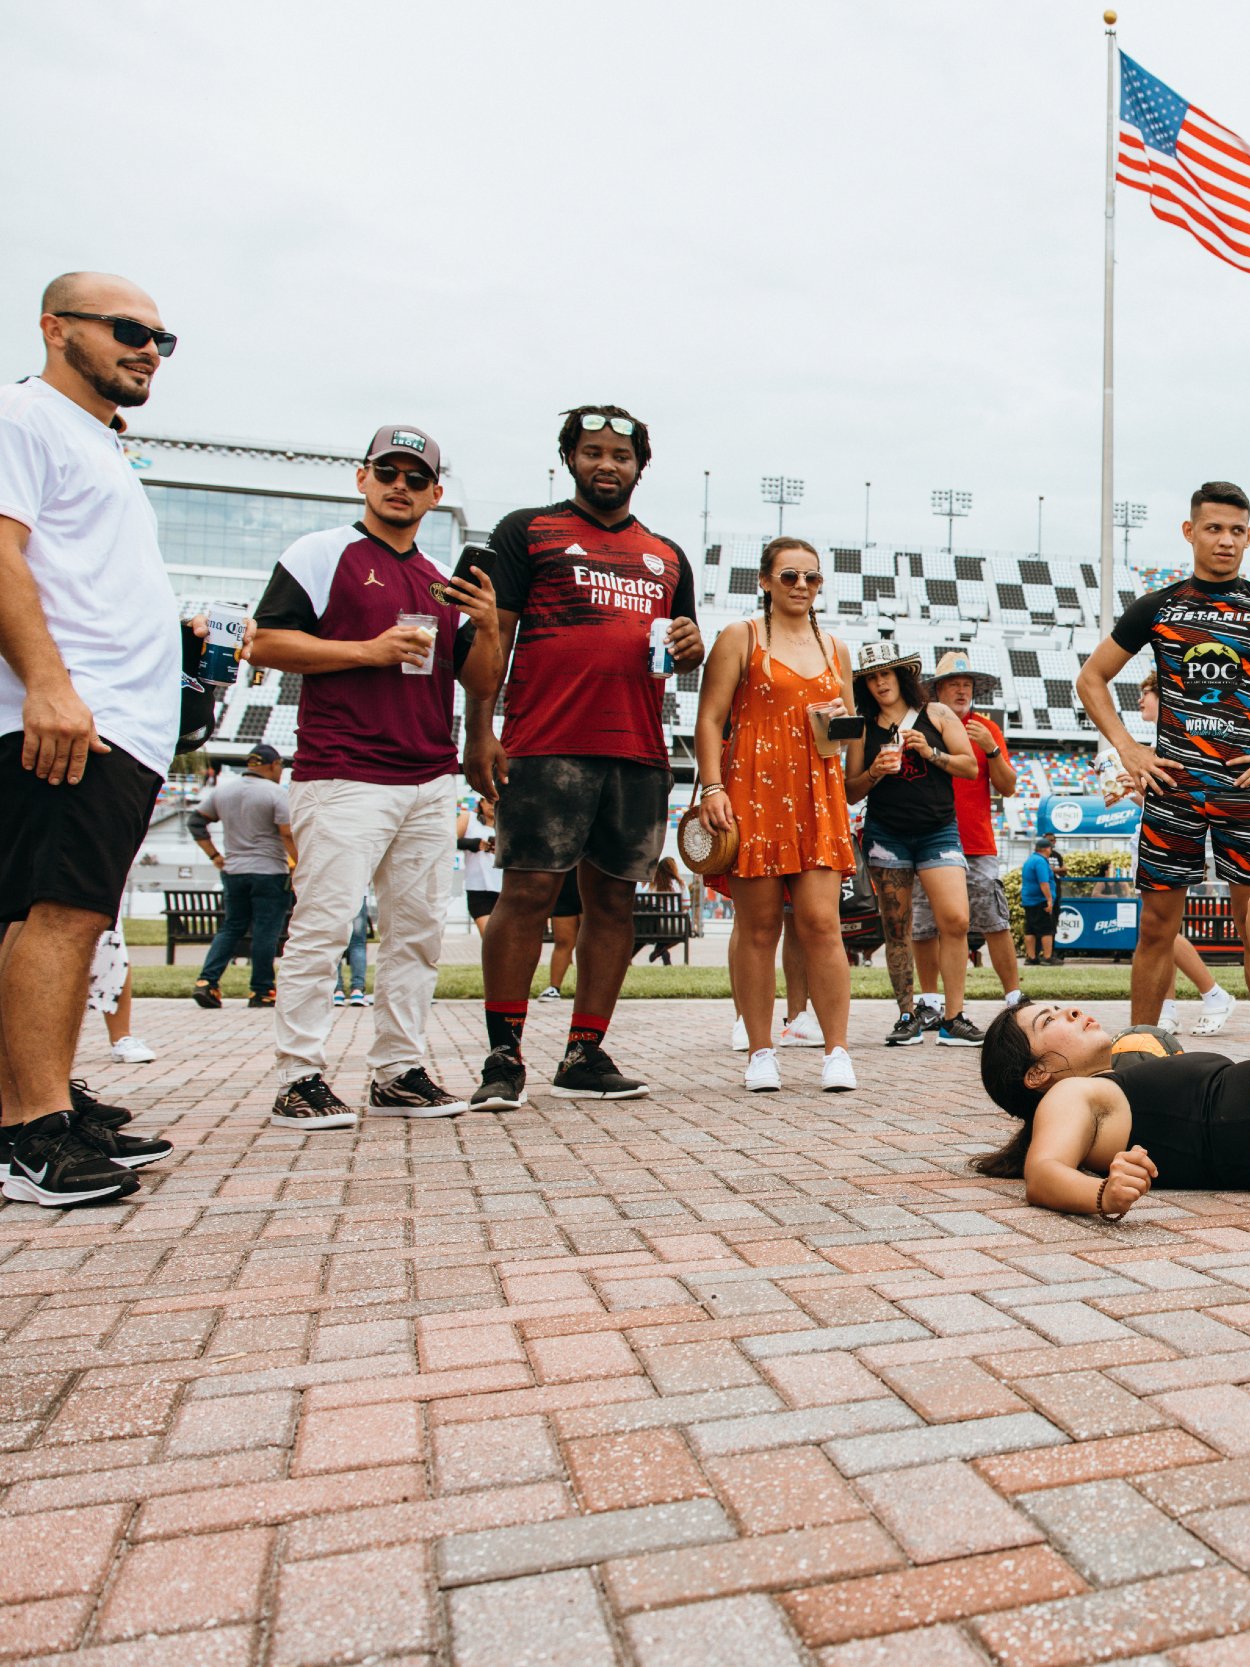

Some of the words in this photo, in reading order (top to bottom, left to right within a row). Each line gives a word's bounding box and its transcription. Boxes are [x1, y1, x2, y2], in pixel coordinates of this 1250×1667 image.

[573, 566, 664, 600] Emirates
[591, 589, 610, 605] FLY
[614, 592, 652, 614] BETTER
[1187, 661, 1238, 680] POC
[1096, 810, 1135, 825] BUSCH
[1058, 919, 1080, 929] USCH
[1095, 919, 1117, 931] BUS
